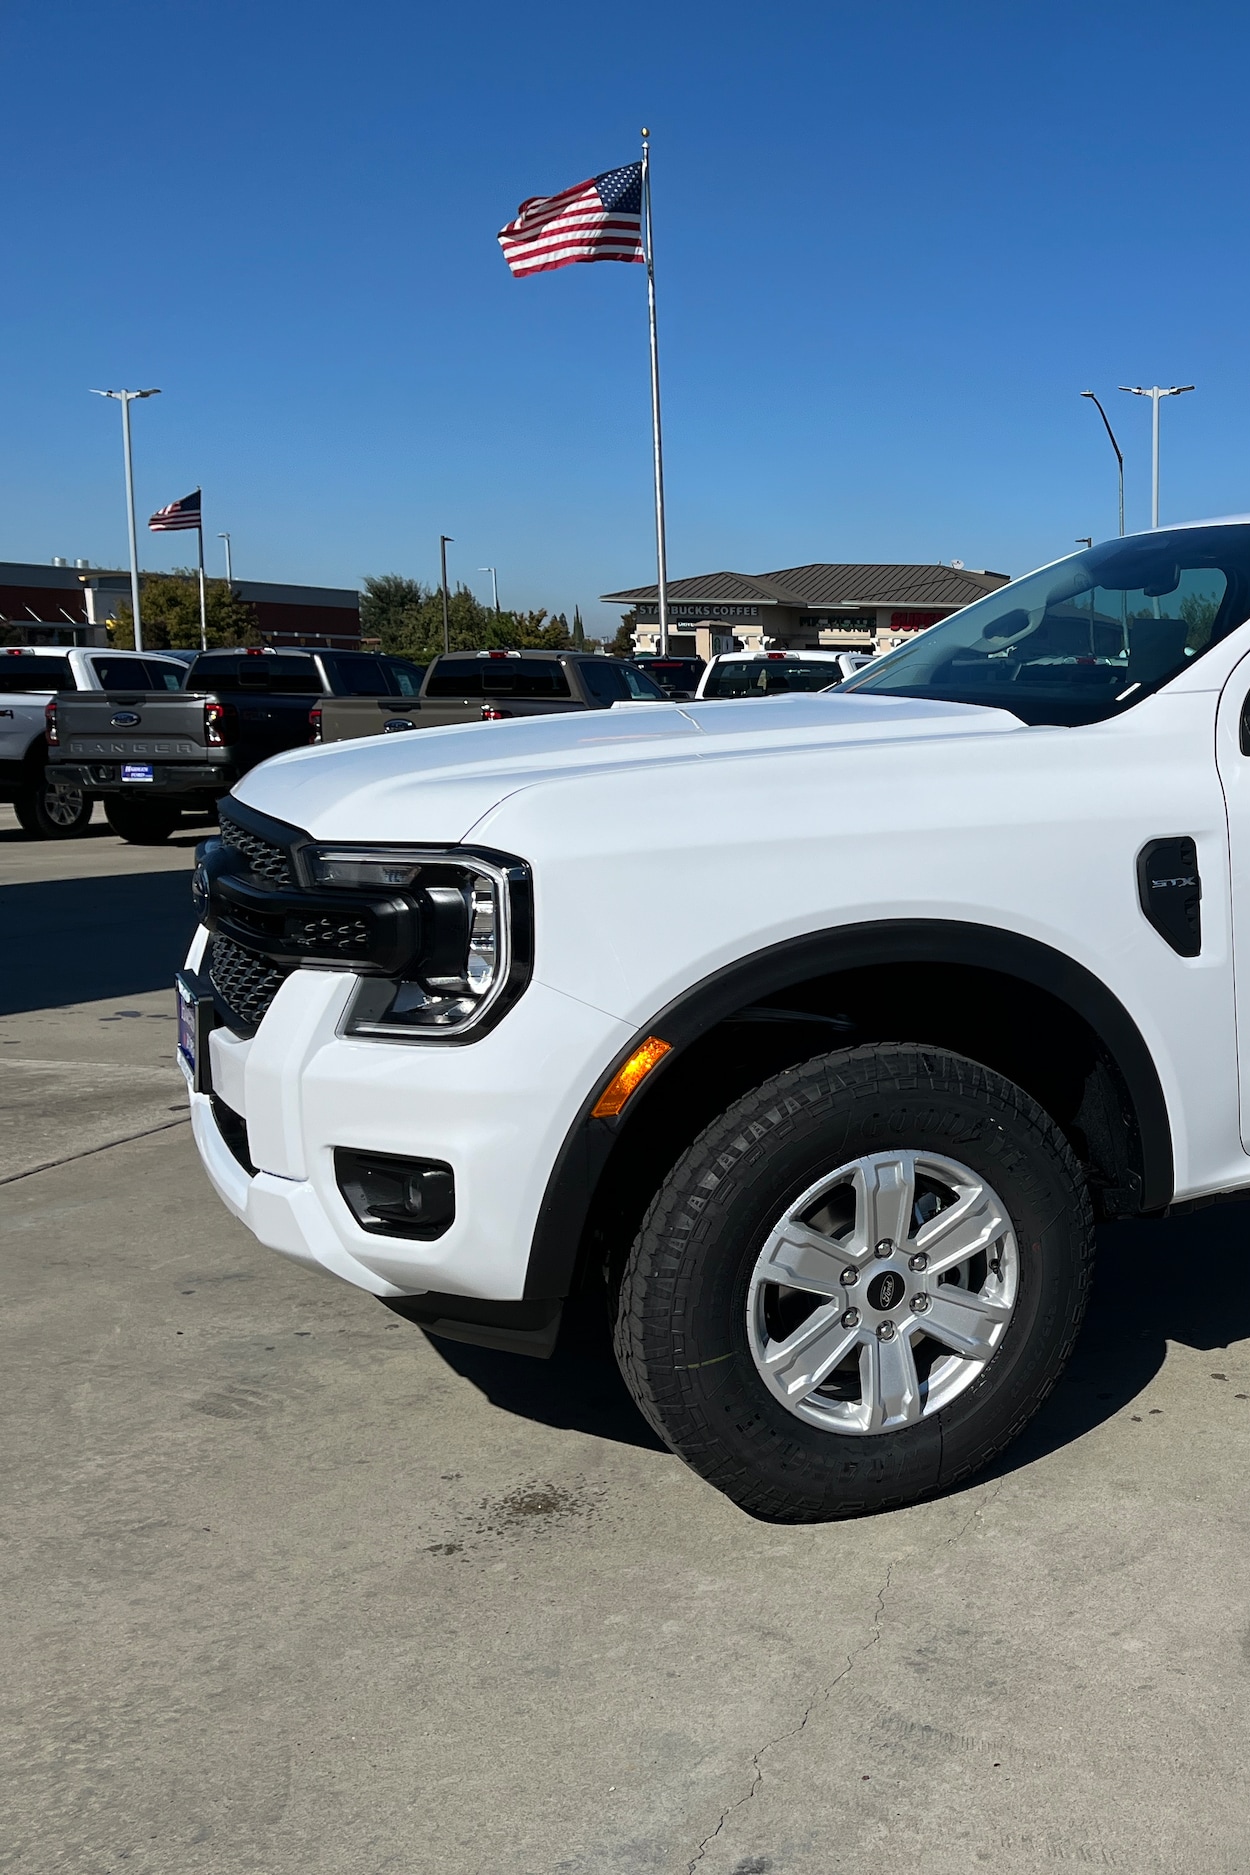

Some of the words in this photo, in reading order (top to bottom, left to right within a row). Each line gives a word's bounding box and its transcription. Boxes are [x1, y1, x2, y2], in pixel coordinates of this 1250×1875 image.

[639, 604, 710, 615] STABUCKS
[713, 606, 758, 616] COFFEE
[70, 743, 192, 753] RANGER
[1151, 876, 1197, 888] STX
[860, 1106, 1056, 1217] GOODYEAR
